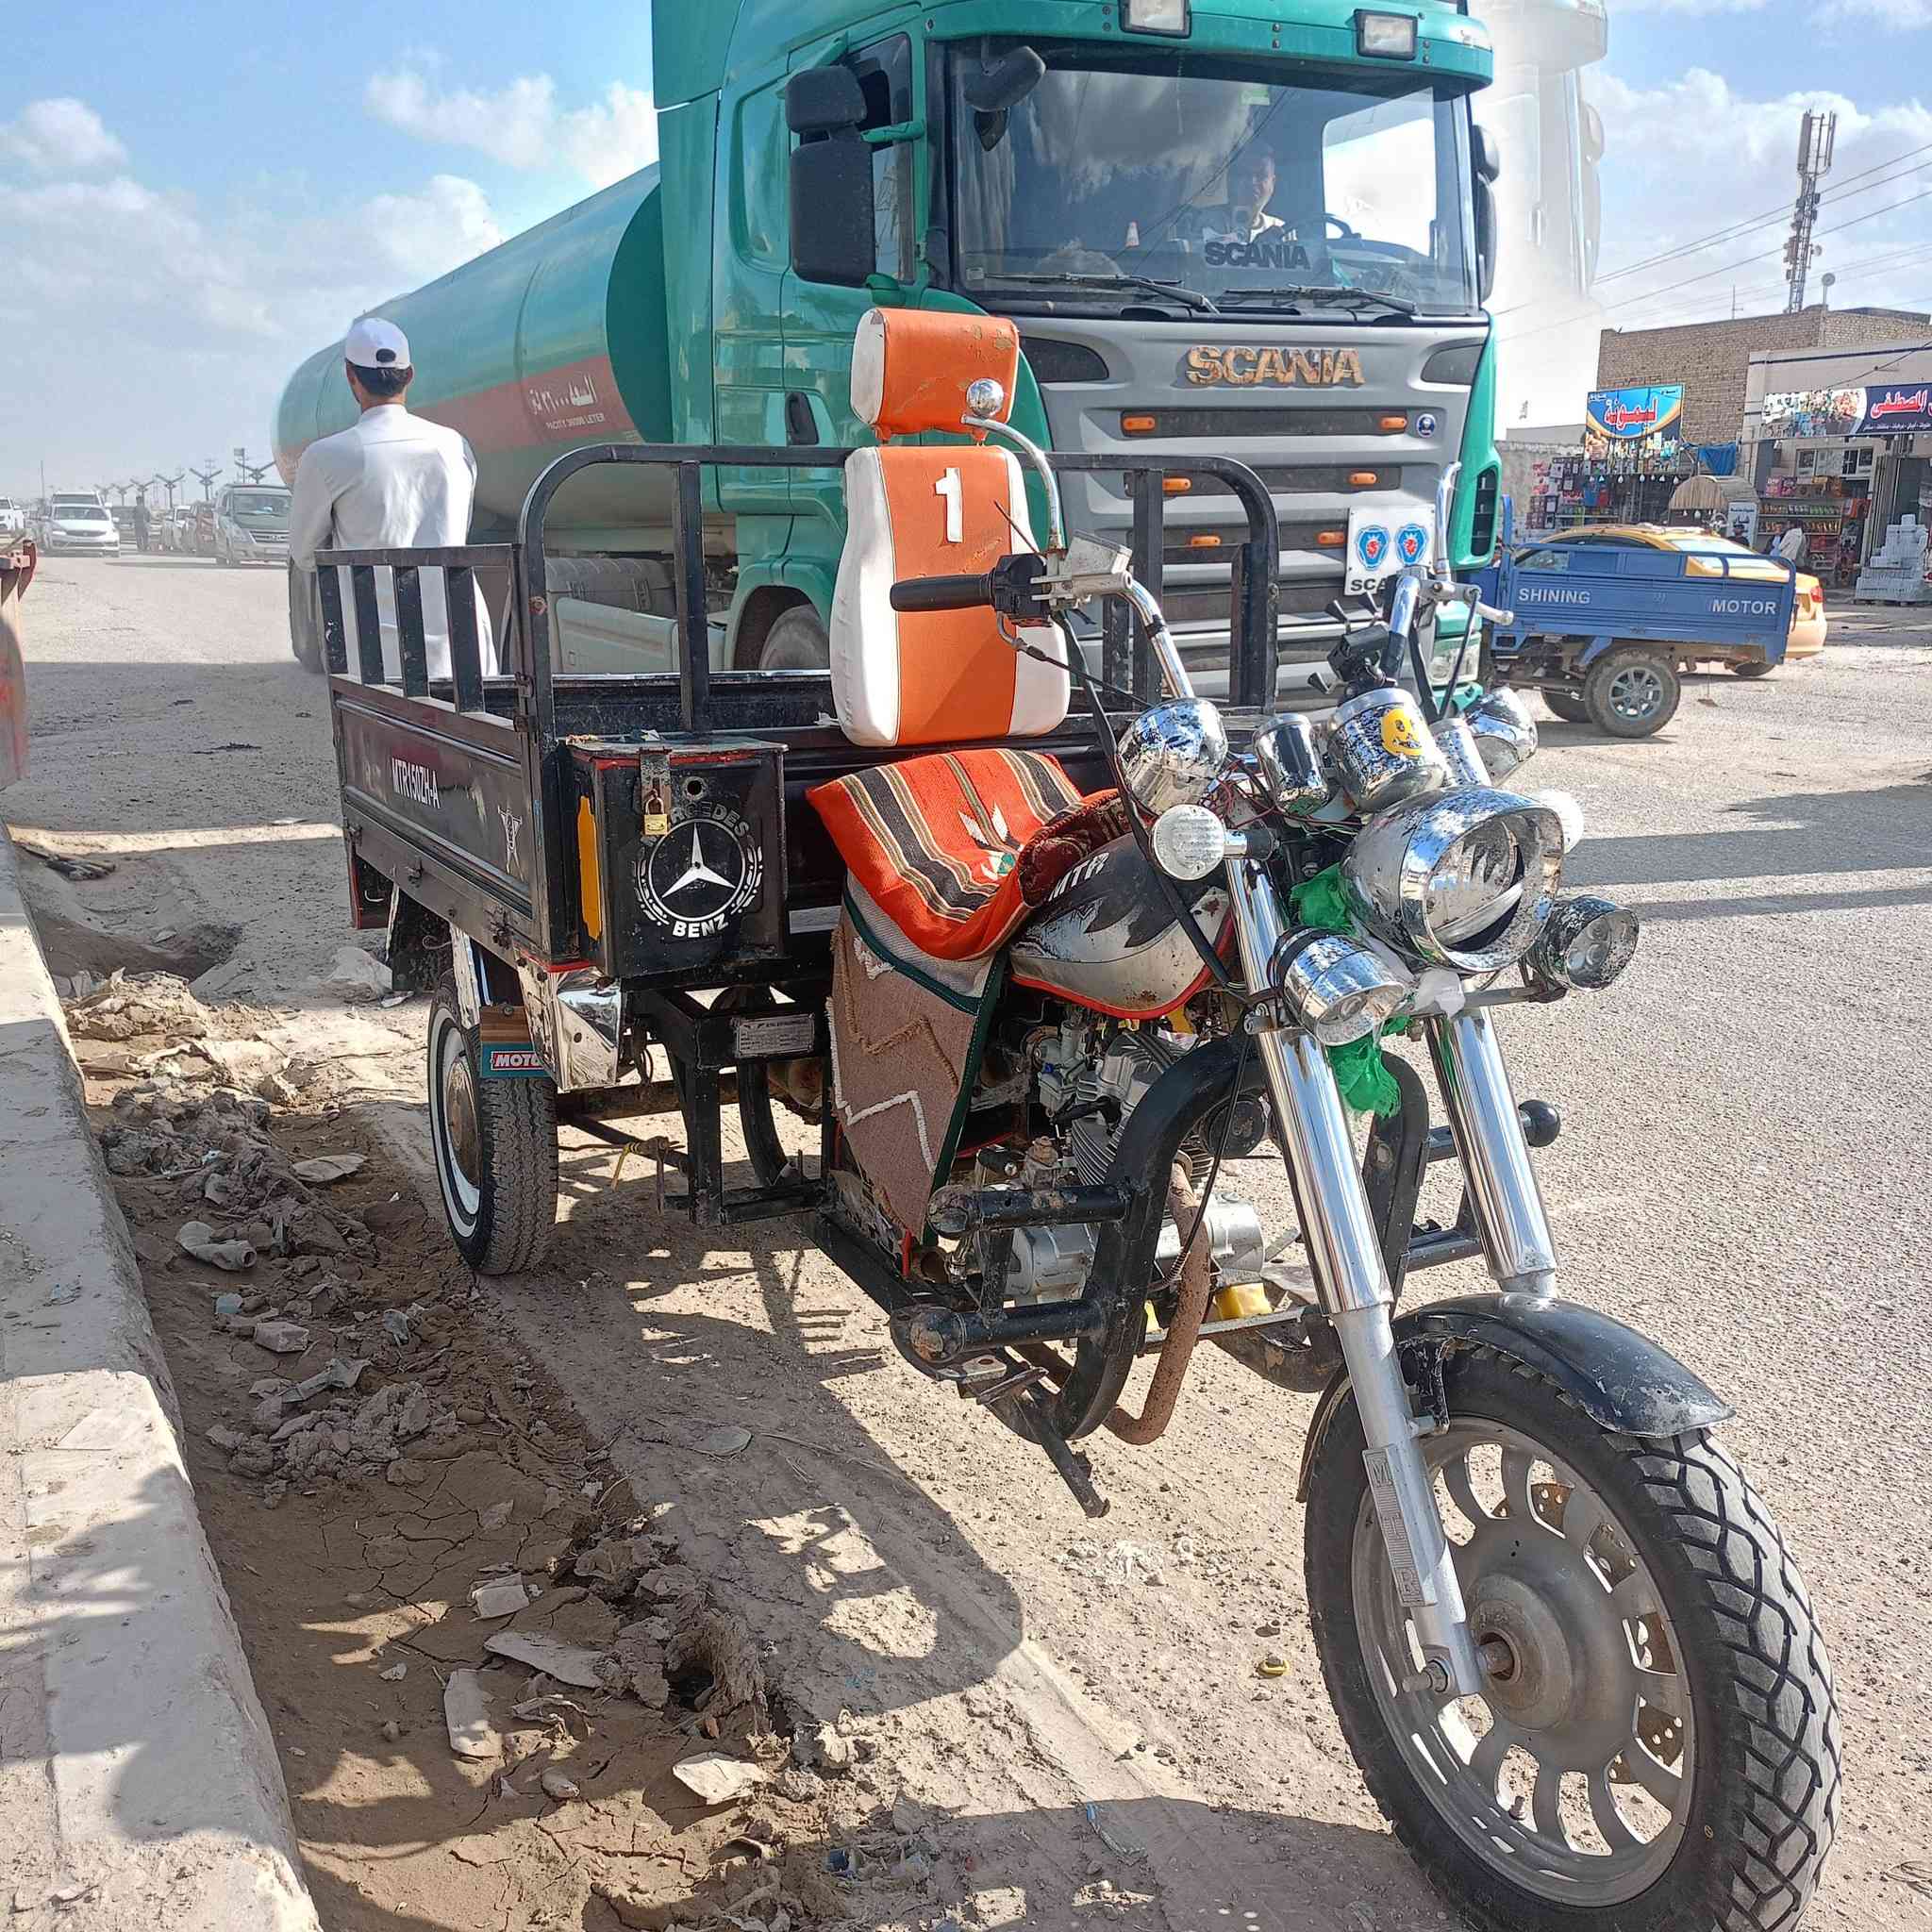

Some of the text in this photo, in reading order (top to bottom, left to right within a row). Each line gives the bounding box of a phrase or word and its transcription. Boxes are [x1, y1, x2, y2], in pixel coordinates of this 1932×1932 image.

[1205, 242, 1311, 270] SCANIA
[1186, 346, 1365, 387] SCANIA
[935, 467, 962, 543] 1
[1351, 577, 1387, 591] SCA
[1518, 588, 1777, 614] SHINING MOTOR
[1048, 852, 1110, 902] MTR
[672, 912, 729, 939] BENZ
[494, 1054, 544, 1067] MOTO
